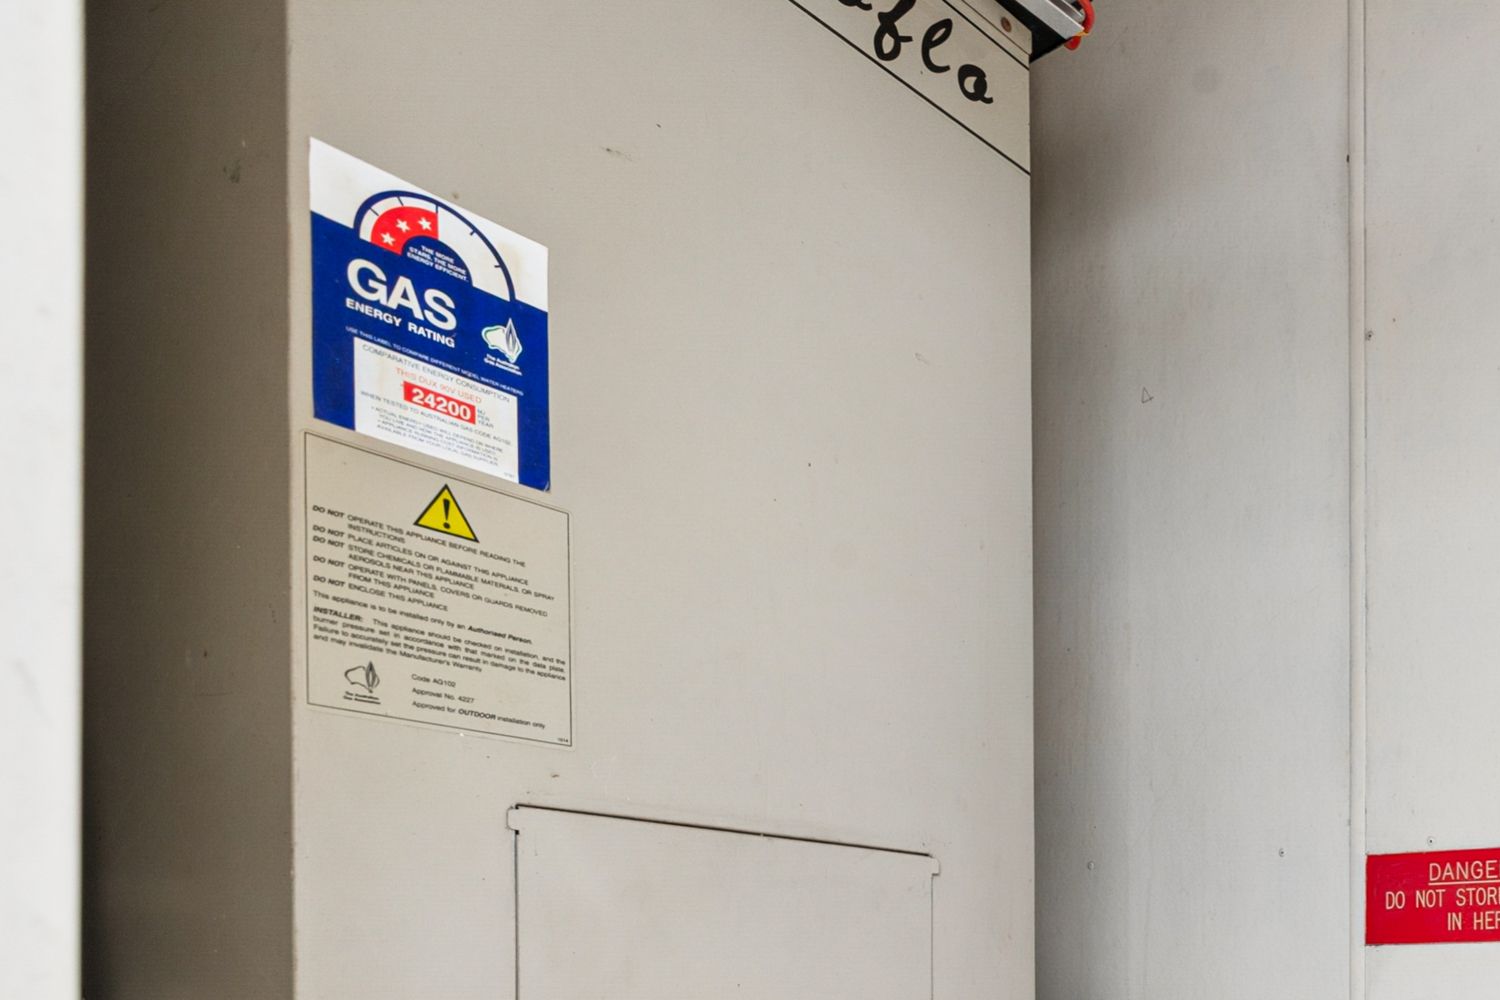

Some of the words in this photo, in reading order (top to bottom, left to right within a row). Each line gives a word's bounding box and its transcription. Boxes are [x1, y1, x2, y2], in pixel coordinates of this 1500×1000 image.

[407, 252, 433, 266] ENERGY
[435, 252, 454, 264] MORE
[448, 264, 466, 275] MORE
[348, 258, 456, 330] GAS
[346, 298, 402, 326] ENERGY
[408, 322, 455, 348] RATING
[362, 344, 418, 369] COMPARATIVE
[422, 366, 453, 382] ENERGY
[456, 378, 509, 402] CONSUMPTION
[412, 388, 470, 420] 24200
[312, 504, 325, 513] DO
[327, 508, 344, 518] NOT
[347, 514, 383, 529] OPERATE
[387, 525, 403, 534] THIS
[406, 530, 446, 546] APPLIANCE
[449, 542, 476, 554] BEFORE
[480, 550, 510, 563] READING
[348, 523, 405, 543] INSTRUCTIONS
[312, 524, 326, 533] DO
[327, 528, 344, 538] NOT
[348, 533, 373, 545] PLACE
[376, 541, 412, 555] ARTICLES
[415, 551, 426, 559] ON
[441, 558, 471, 570] AGAINST
[474, 567, 489, 575] THIS
[492, 571, 528, 585] APPLIANCE
[312, 535, 326, 544] DO
[327, 539, 344, 548] NOT
[348, 544, 374, 556] STORE
[377, 552, 420, 567] CHEMICALS
[423, 563, 434, 571] OR
[436, 567, 478, 582] FLAMMABLE
[534, 592, 554, 601] SPRAY
[349, 553, 390, 569] AEROSOLS
[393, 564, 414, 574] NEAR
[417, 570, 432, 579] THIS
[435, 575, 473, 589] APPLIANCE
[313, 555, 326, 563] DO
[327, 558, 345, 568] NOT
[348, 563, 383, 577] OPERATE
[387, 573, 406, 582] WITH
[441, 586, 470, 598] COVERS
[485, 597, 513, 608] GUARDS
[515, 605, 547, 616] REMOVED
[313, 574, 326, 583] DO
[328, 578, 345, 587] NOT
[348, 583, 385, 596] ENCLOSE
[388, 592, 405, 601] THIS
[408, 597, 447, 611] APPLIANCE
[348, 572, 371, 583] FROM
[374, 578, 391, 588] THIS
[393, 583, 434, 598] APPLIANCE
[1386, 891, 1405, 910] DO
[1416, 889, 1446, 908] NOT
[1448, 912, 1462, 930] IN
